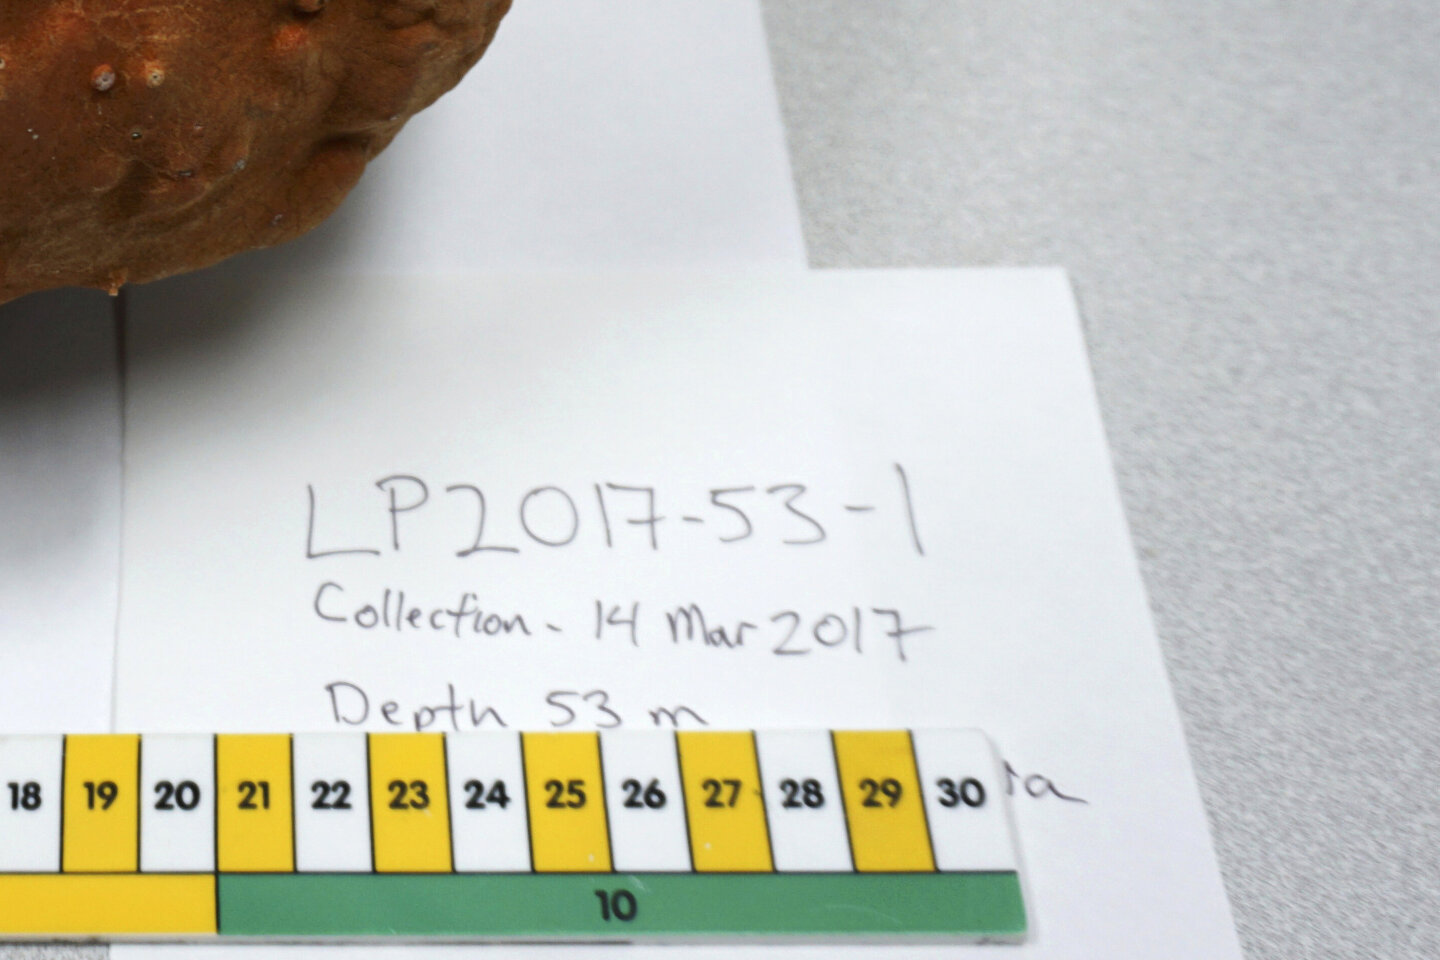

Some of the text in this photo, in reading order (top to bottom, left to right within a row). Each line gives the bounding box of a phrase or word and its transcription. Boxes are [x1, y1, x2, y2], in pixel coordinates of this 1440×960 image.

[305, 462, 925, 559] LP2017-53-1
[594, 599, 640, 646] 14
[665, 602, 758, 649] Mar
[770, 607, 936, 662] 2017
[324, 681, 710, 732] Depth 53 m
[8, 780, 43, 811] 18
[83, 780, 119, 811] 19
[153, 780, 201, 810] 20
[237, 780, 271, 810] 21
[310, 779, 352, 810] 22
[387, 779, 431, 810] 23
[463, 779, 511, 810] 24
[544, 779, 587, 810] 25
[621, 779, 667, 810] 26
[701, 779, 742, 809] 27
[779, 778, 825, 809] 28
[859, 778, 903, 809] 29
[937, 778, 986, 809] 30
[593, 889, 639, 922] 10
